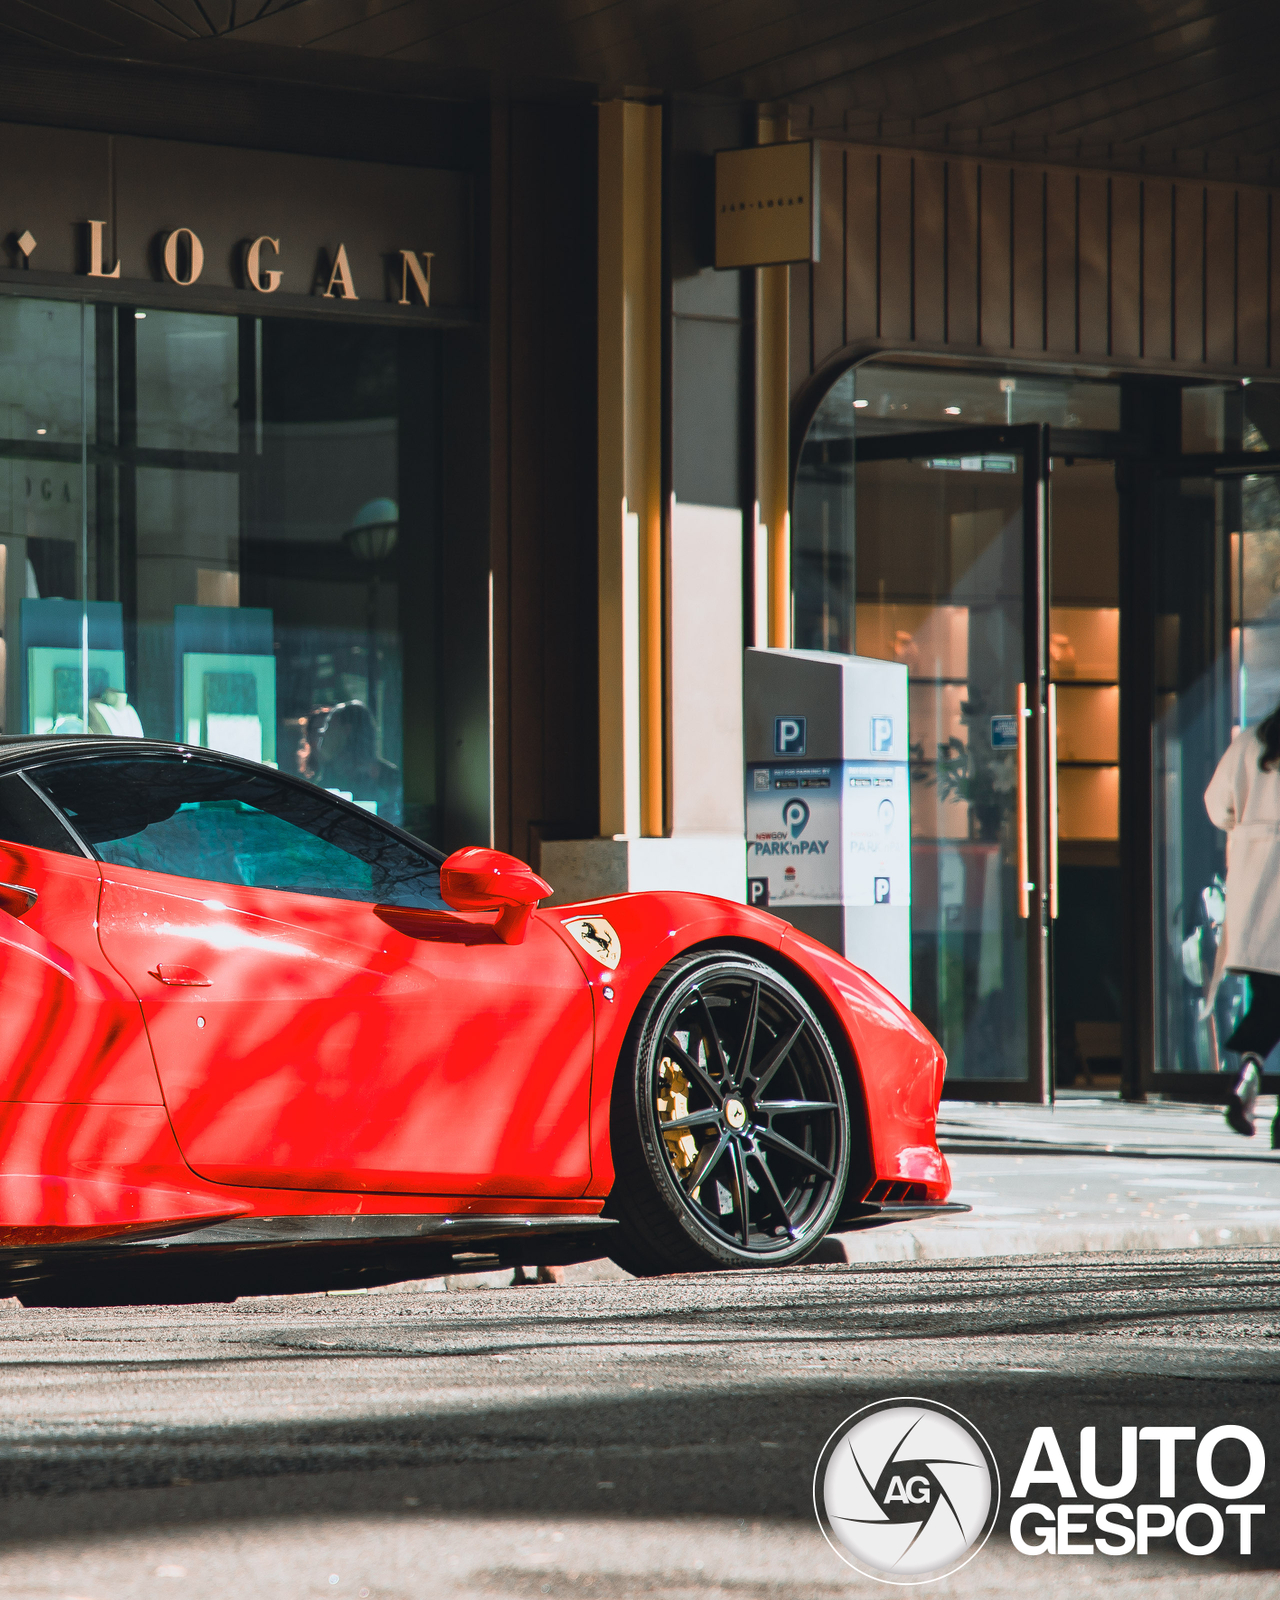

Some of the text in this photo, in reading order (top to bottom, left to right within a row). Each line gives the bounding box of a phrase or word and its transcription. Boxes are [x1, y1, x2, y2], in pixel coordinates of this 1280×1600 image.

[87, 219, 435, 307] LOGAN
[780, 720, 800, 751] P
[875, 719, 891, 751] P
[751, 882, 763, 903] P
[876, 878, 890, 903] P
